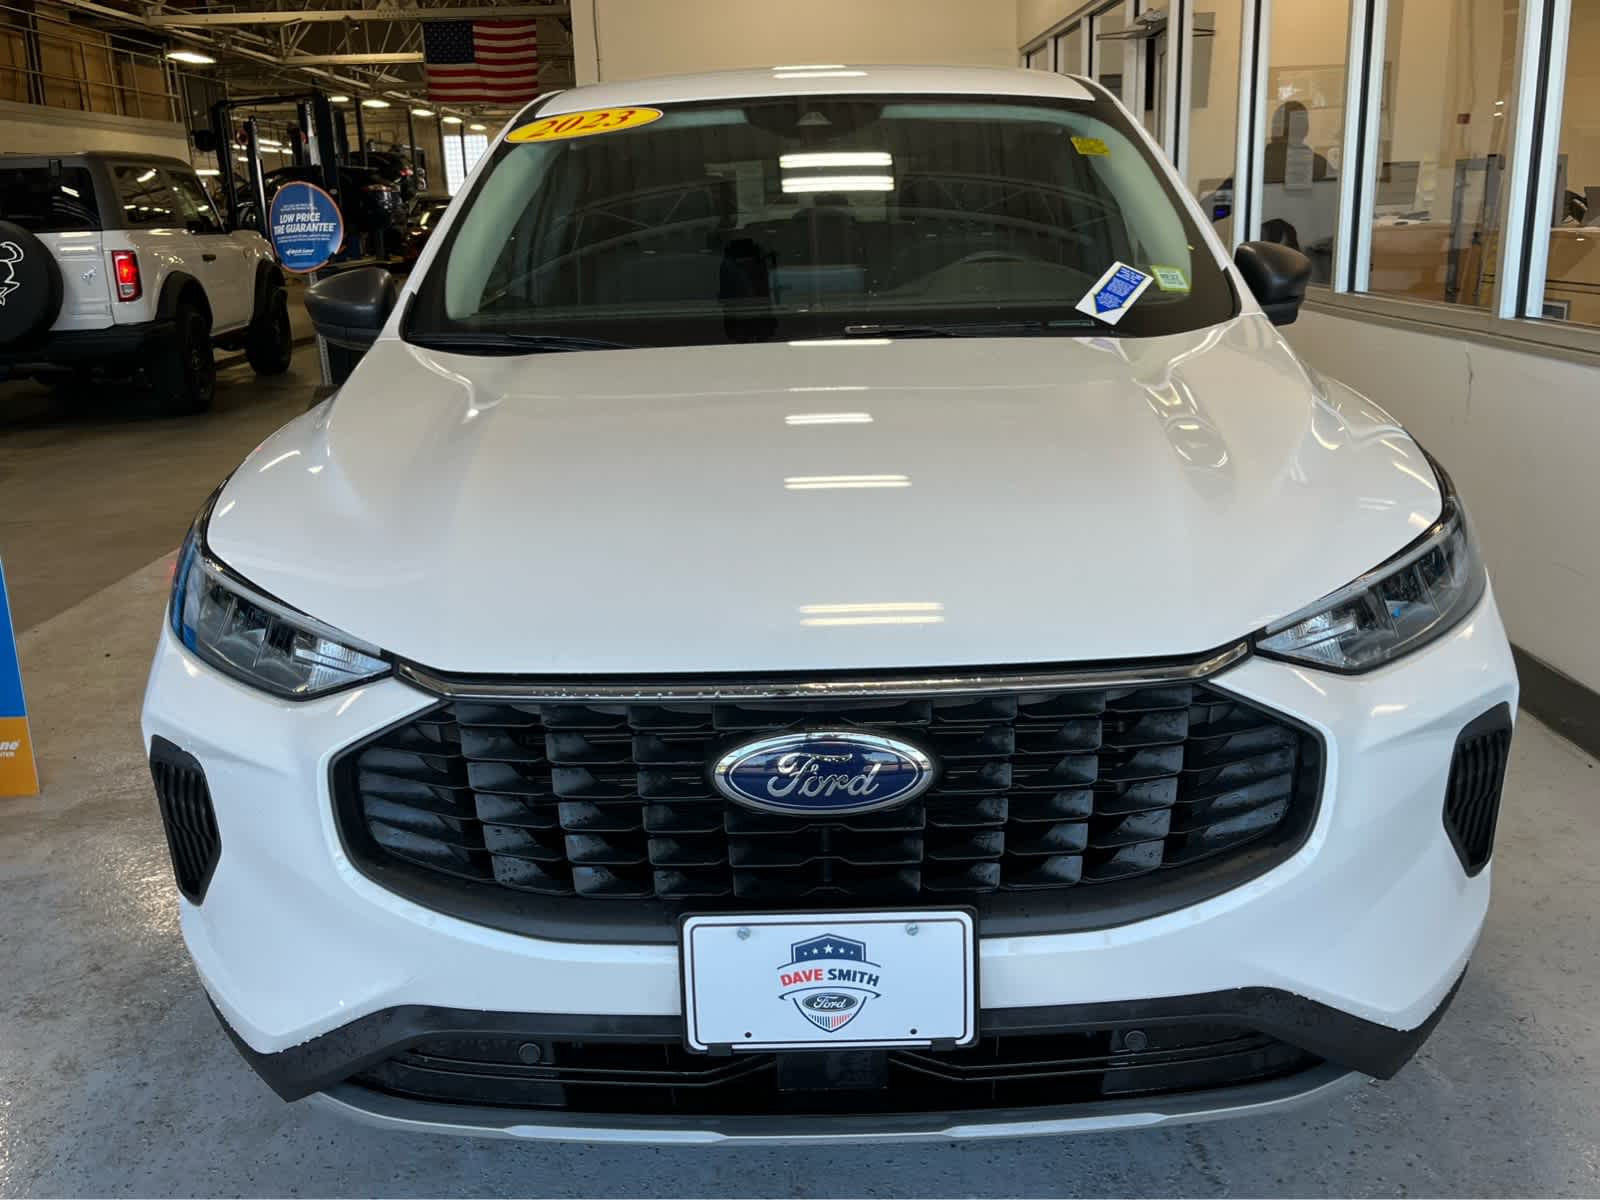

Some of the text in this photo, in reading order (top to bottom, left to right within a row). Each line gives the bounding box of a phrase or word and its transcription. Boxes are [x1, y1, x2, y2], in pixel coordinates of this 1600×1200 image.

[526, 110, 636, 139] 2023
[280, 212, 320, 224] LOW PRICE
[286, 222, 336, 234] GUARANTEE
[767, 752, 881, 797] Ford
[780, 968, 880, 987] DAVE SMITH
[812, 995, 848, 1009] Ford
